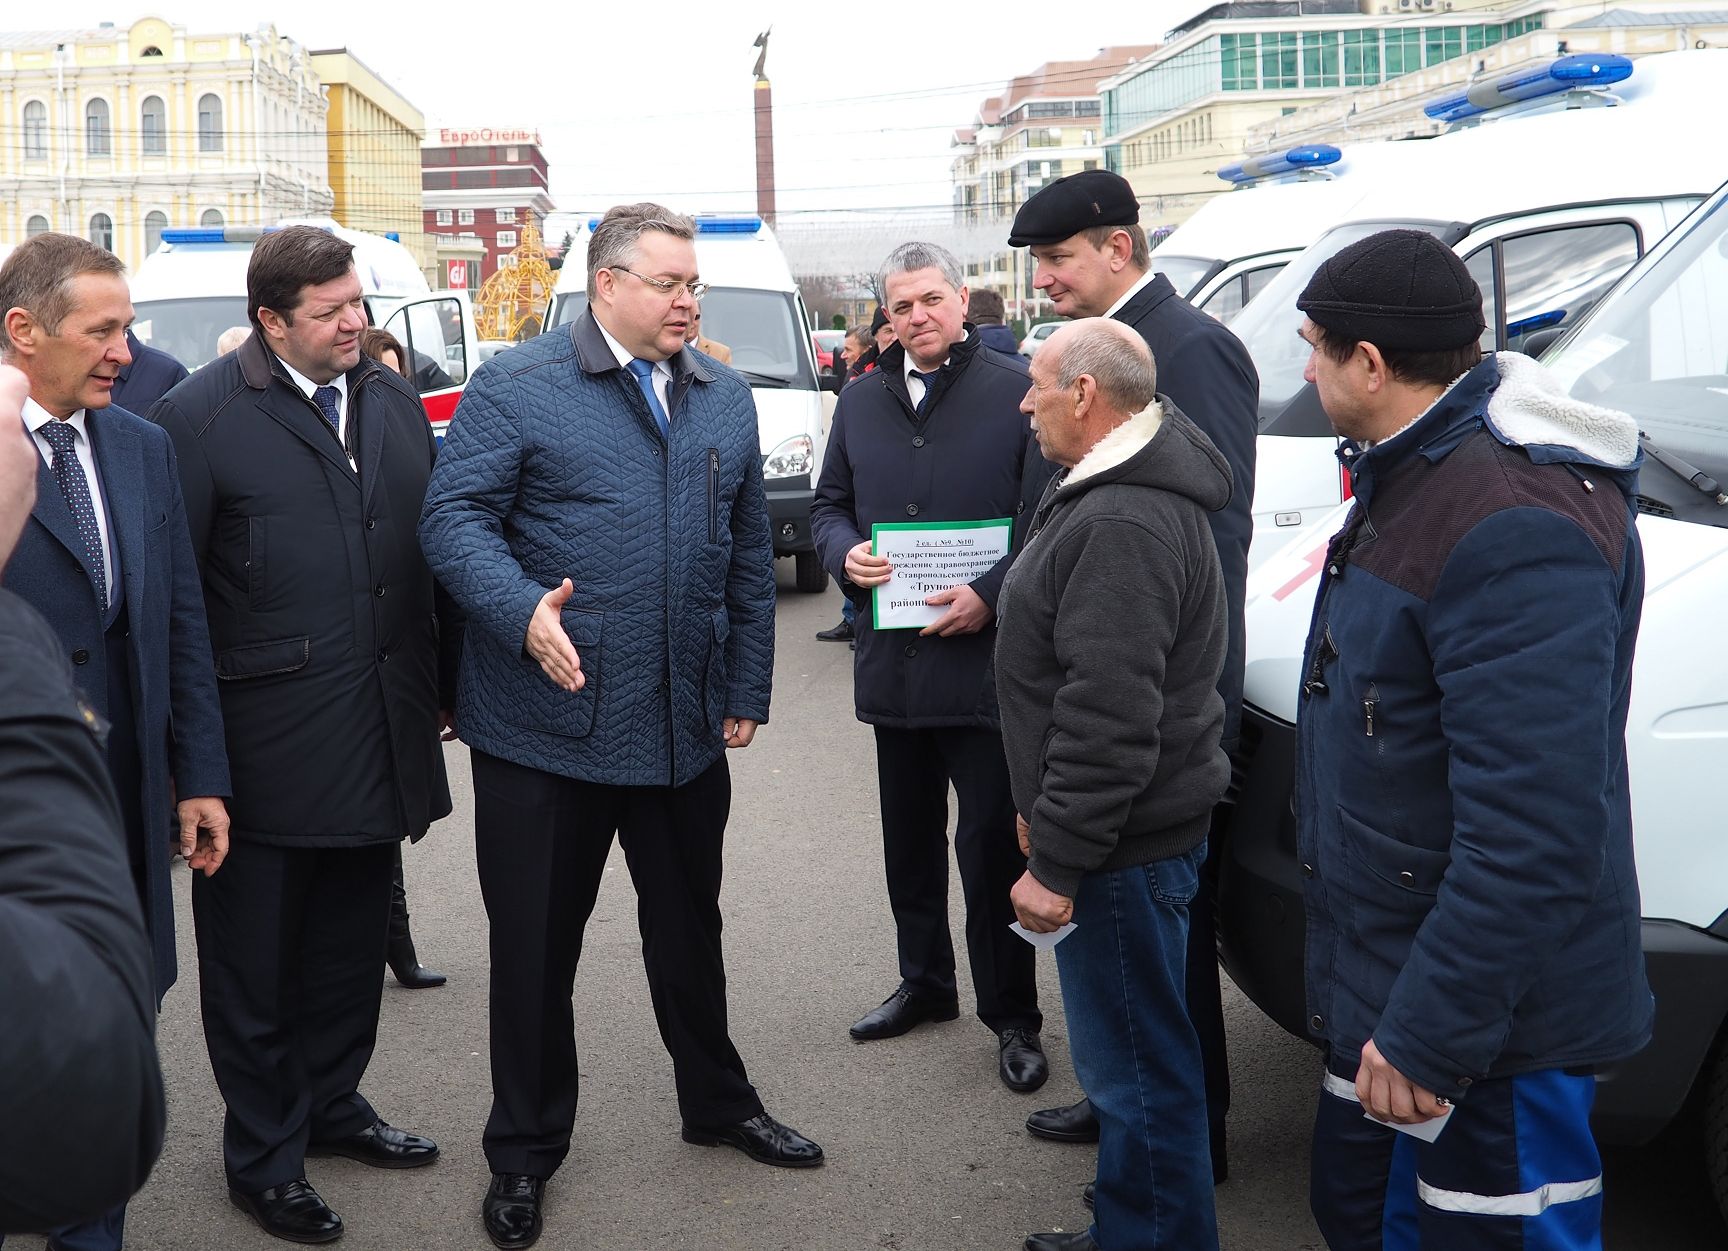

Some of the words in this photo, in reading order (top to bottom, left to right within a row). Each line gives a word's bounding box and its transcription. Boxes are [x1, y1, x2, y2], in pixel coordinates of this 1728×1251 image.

[440, 128, 530, 145] ЕвроОтель
[887, 551, 956, 560] Государственное
[958, 548, 1000, 557] бюджетное
[897, 571, 969, 580] Ставропольского
